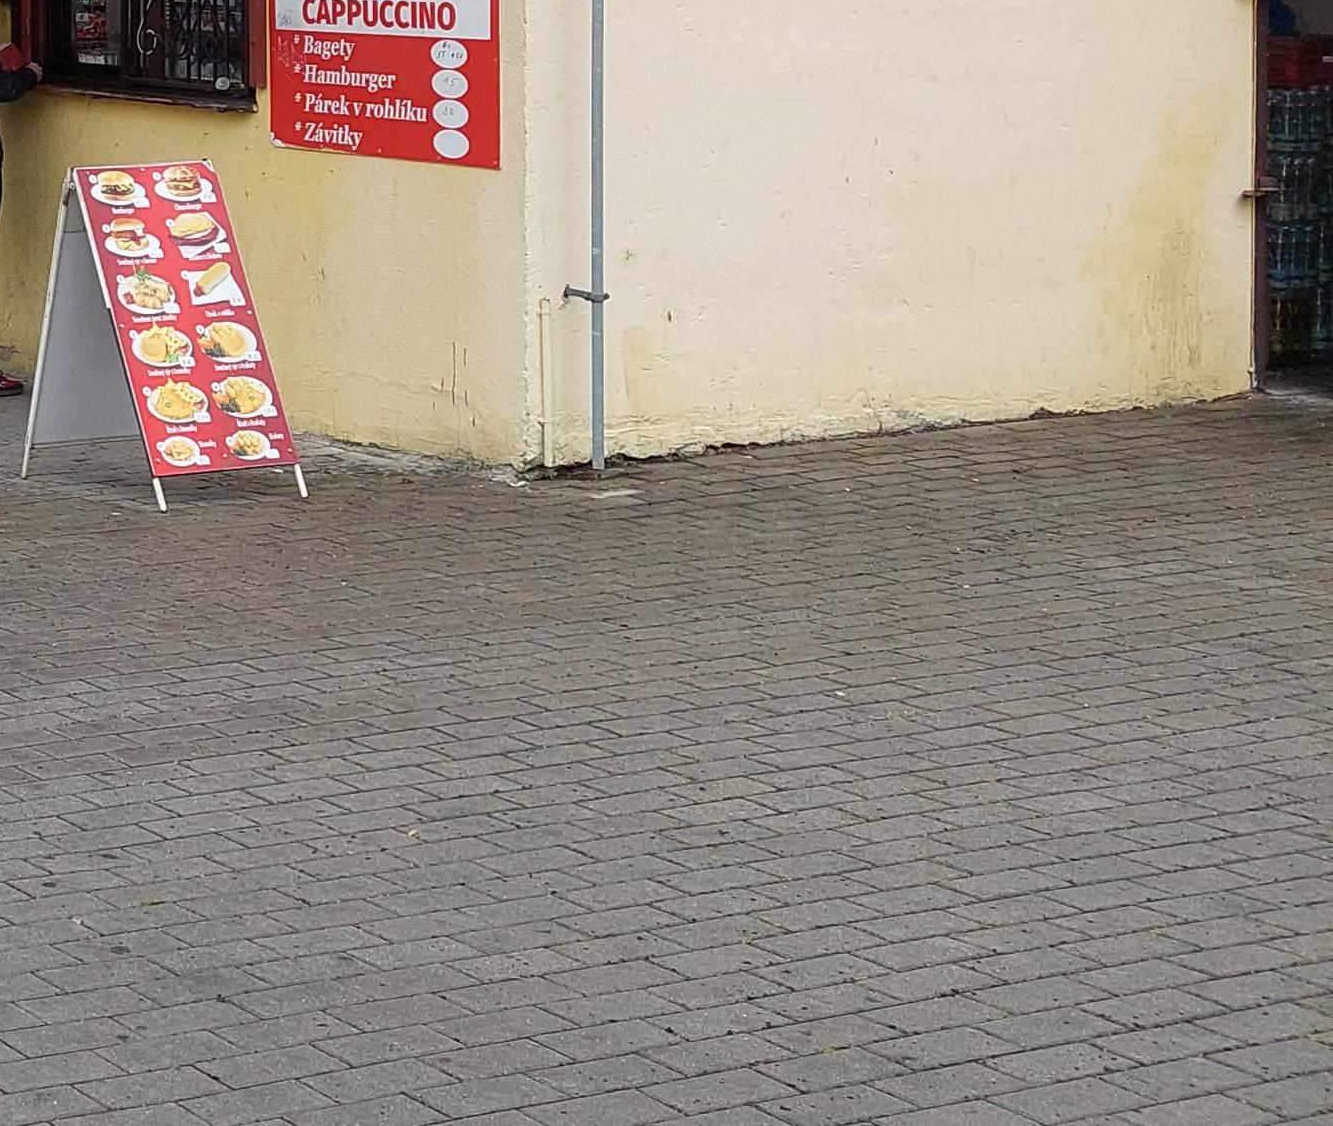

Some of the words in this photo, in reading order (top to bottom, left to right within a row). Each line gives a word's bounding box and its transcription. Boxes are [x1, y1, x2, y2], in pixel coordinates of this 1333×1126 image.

[303, 35, 355, 62] Bagety
[303, 64, 396, 93] Hamburger
[303, 92, 350, 116] Párek
[353, 102, 365, 117] v
[365, 98, 427, 123] rohlíku
[303, 122, 363, 151] Závitky
